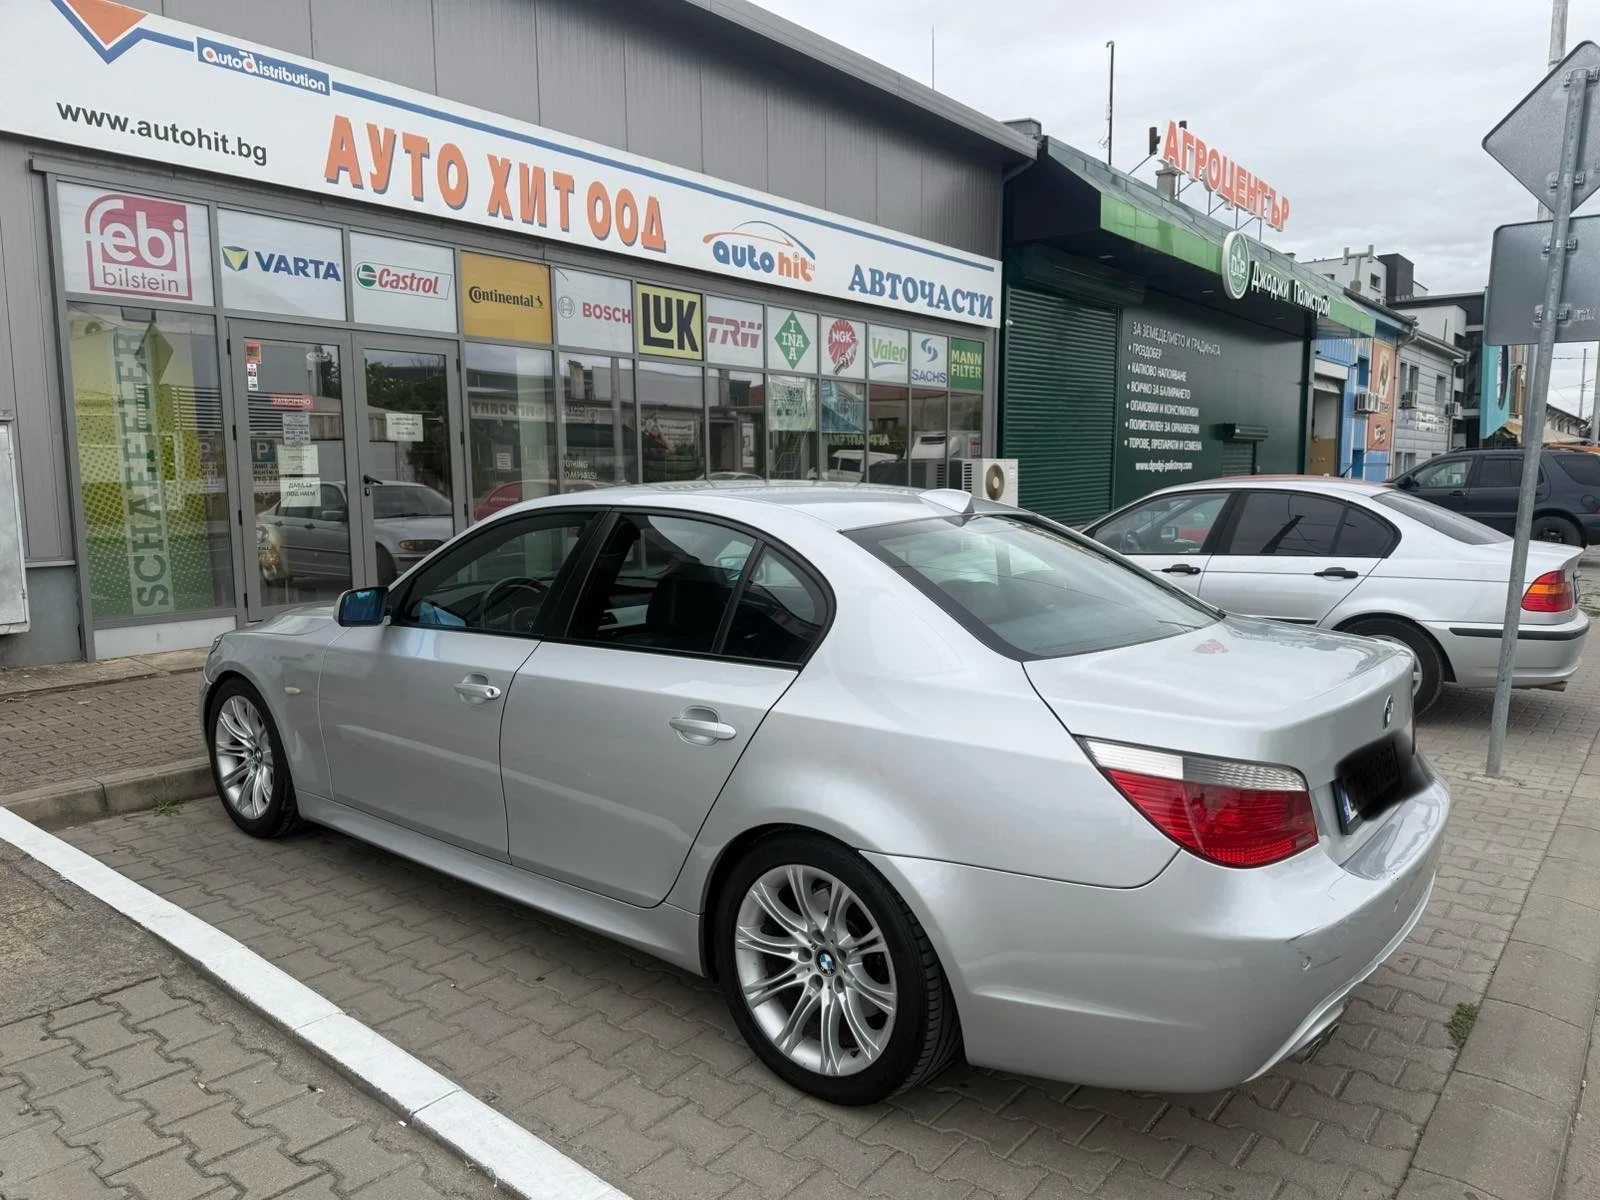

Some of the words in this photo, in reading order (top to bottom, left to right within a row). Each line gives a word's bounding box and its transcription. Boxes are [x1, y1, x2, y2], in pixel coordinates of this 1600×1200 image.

[56, 102, 267, 166] www.autohit.bg
[324, 114, 469, 211] АУТО
[487, 153, 575, 232] ХИТ
[586, 181, 666, 253] ООД
[1162, 119, 1292, 232] АГРОЦЕНТЪР
[85, 198, 186, 270] febi
[255, 250, 342, 282] VARTA
[712, 240, 775, 273] auto
[778, 251, 812, 282] hit
[102, 265, 179, 292] bilstein
[378, 267, 439, 295] Castrol
[848, 264, 994, 319] АВТОЧАСТИ
[468, 286, 534, 308] Continental
[1294, 280, 1331, 319] Полистрой
[582, 302, 631, 324] BOSCH
[707, 315, 762, 349] TRW
[832, 330, 852, 343] NGK
[871, 337, 908, 362] Valeo
[951, 349, 982, 365] MANN
[911, 368, 947, 384] SACHS
[951, 364, 981, 378] FILTER
